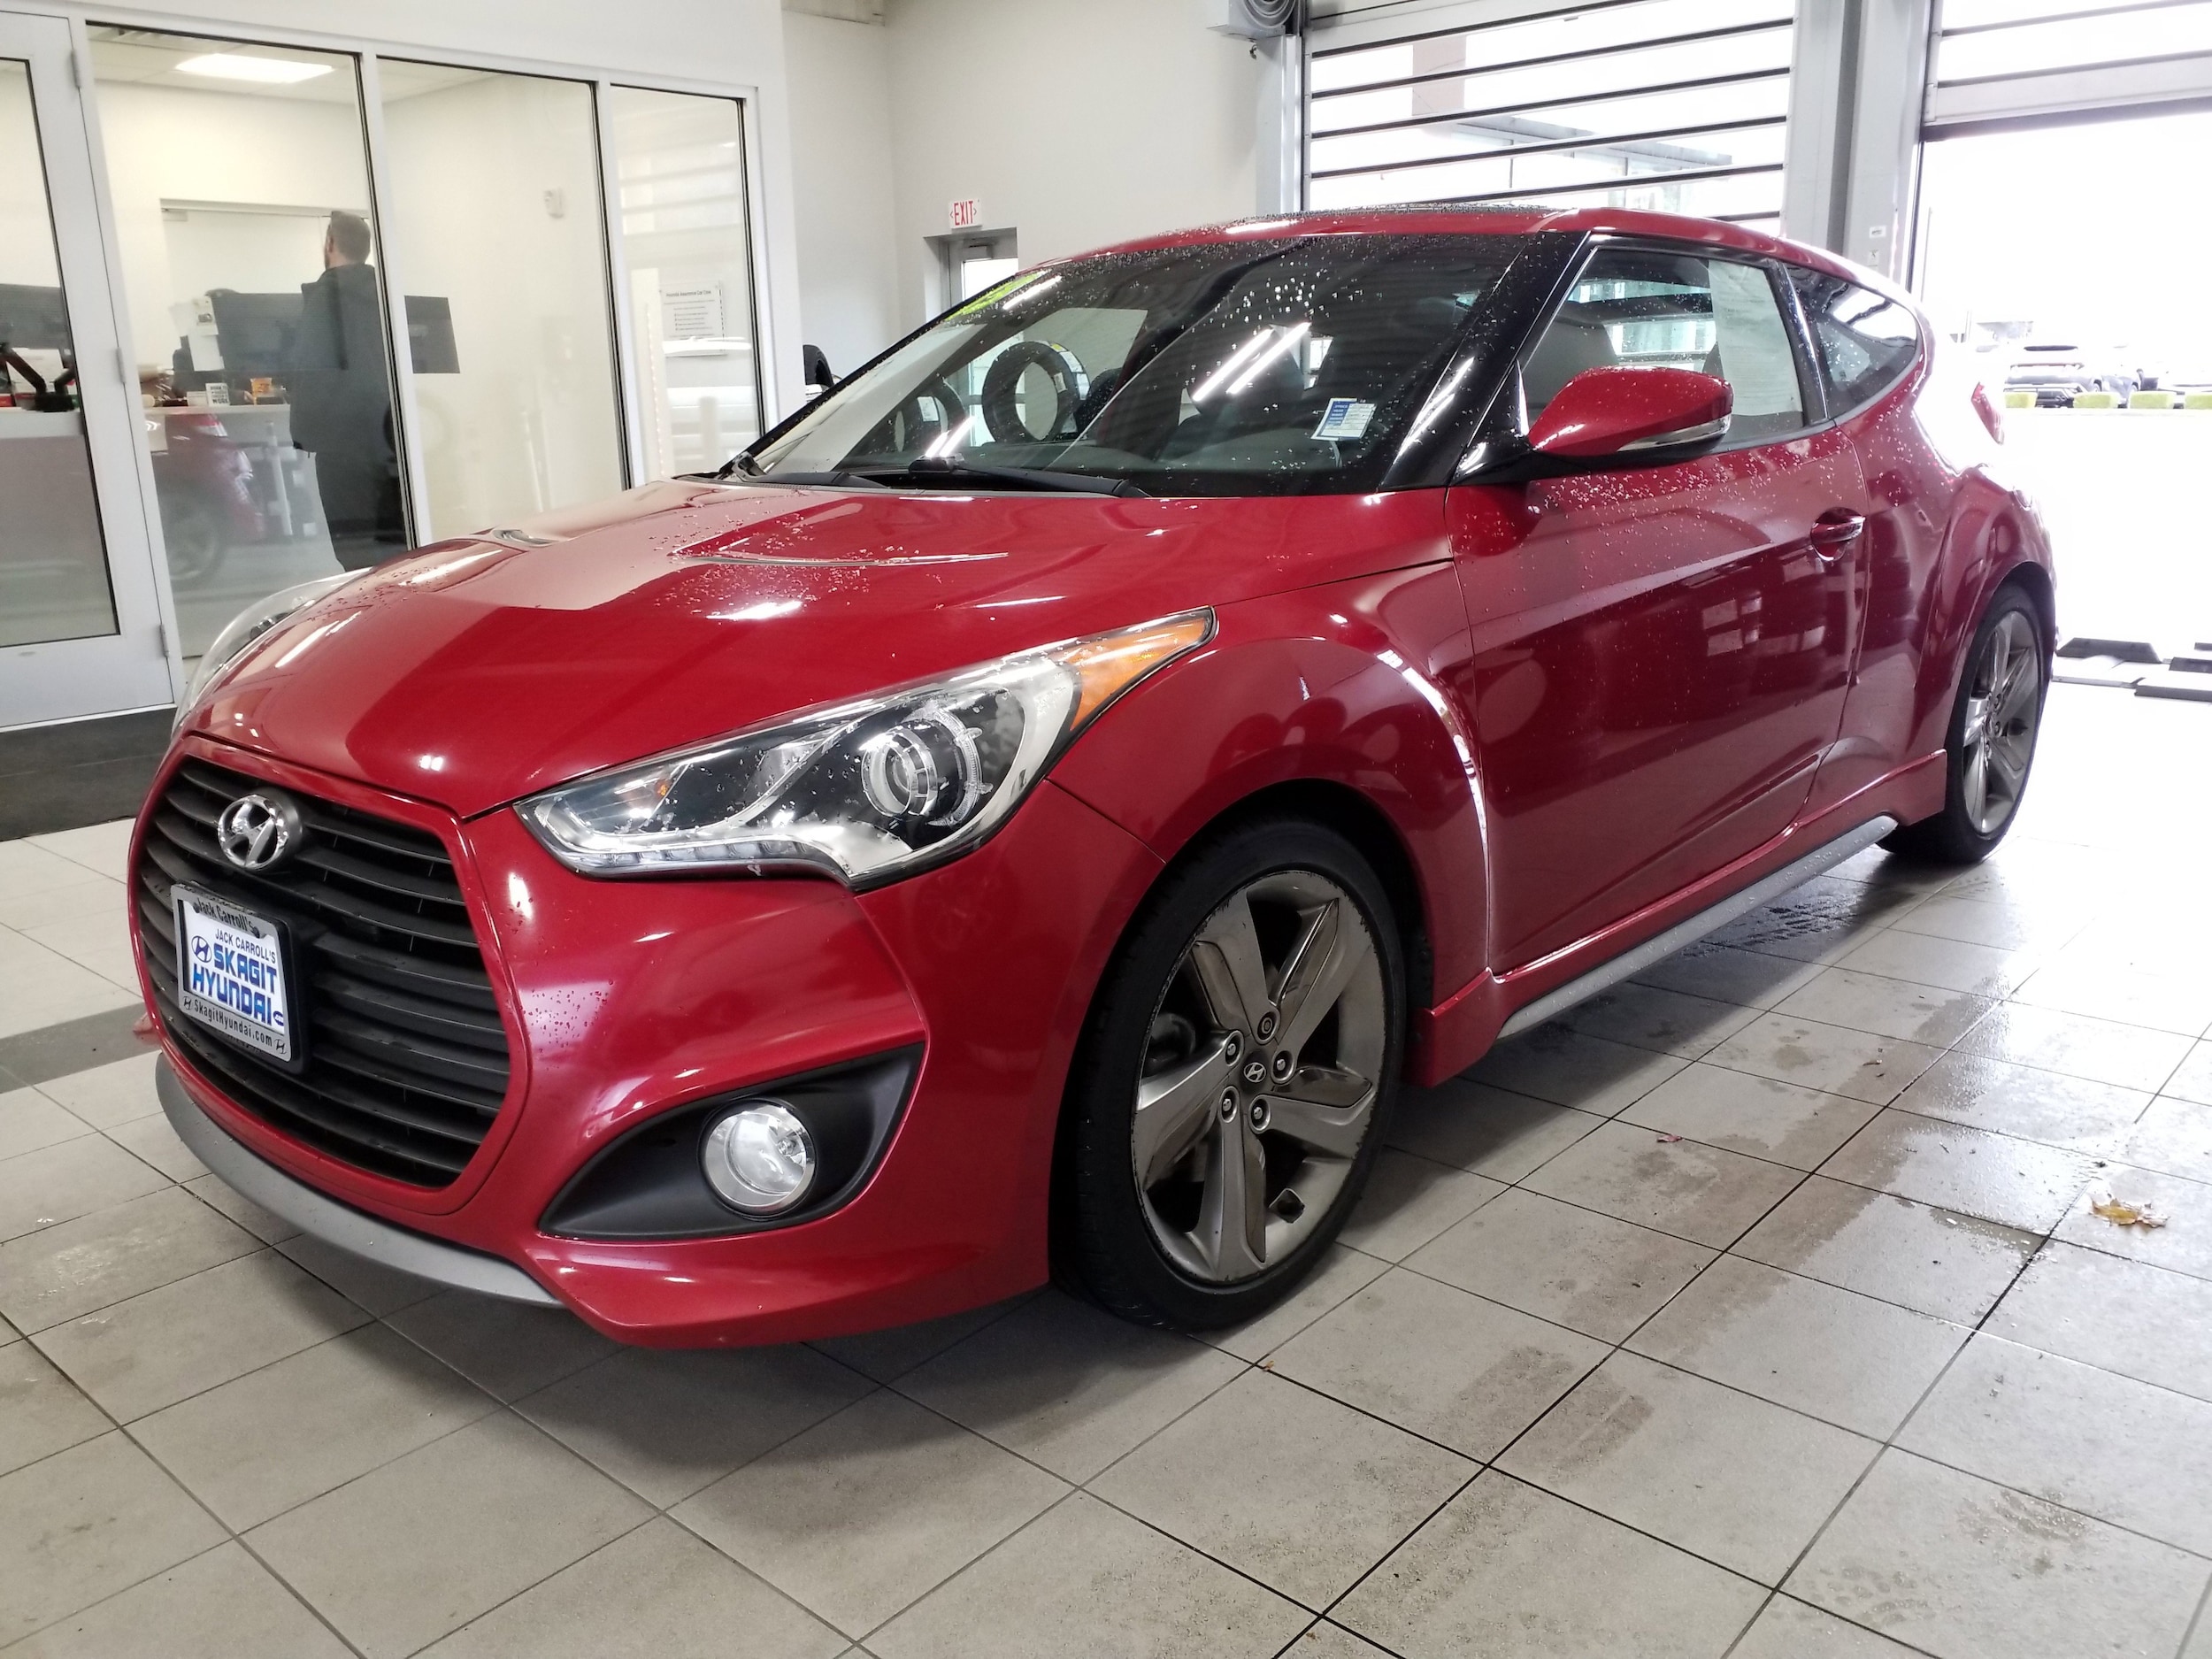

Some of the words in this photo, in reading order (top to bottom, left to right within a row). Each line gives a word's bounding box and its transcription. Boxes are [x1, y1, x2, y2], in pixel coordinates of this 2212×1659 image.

[954, 201, 973, 226] EXIT
[196, 897, 215, 919] Jack
[216, 903, 257, 934] Carroll's
[215, 928, 234, 947] JACK
[235, 936, 276, 964] CARROLL'S
[213, 942, 277, 995] SKAGIT
[192, 963, 273, 1026] HYUNDAI
[194, 999, 273, 1048] SkagitHyundai.com
